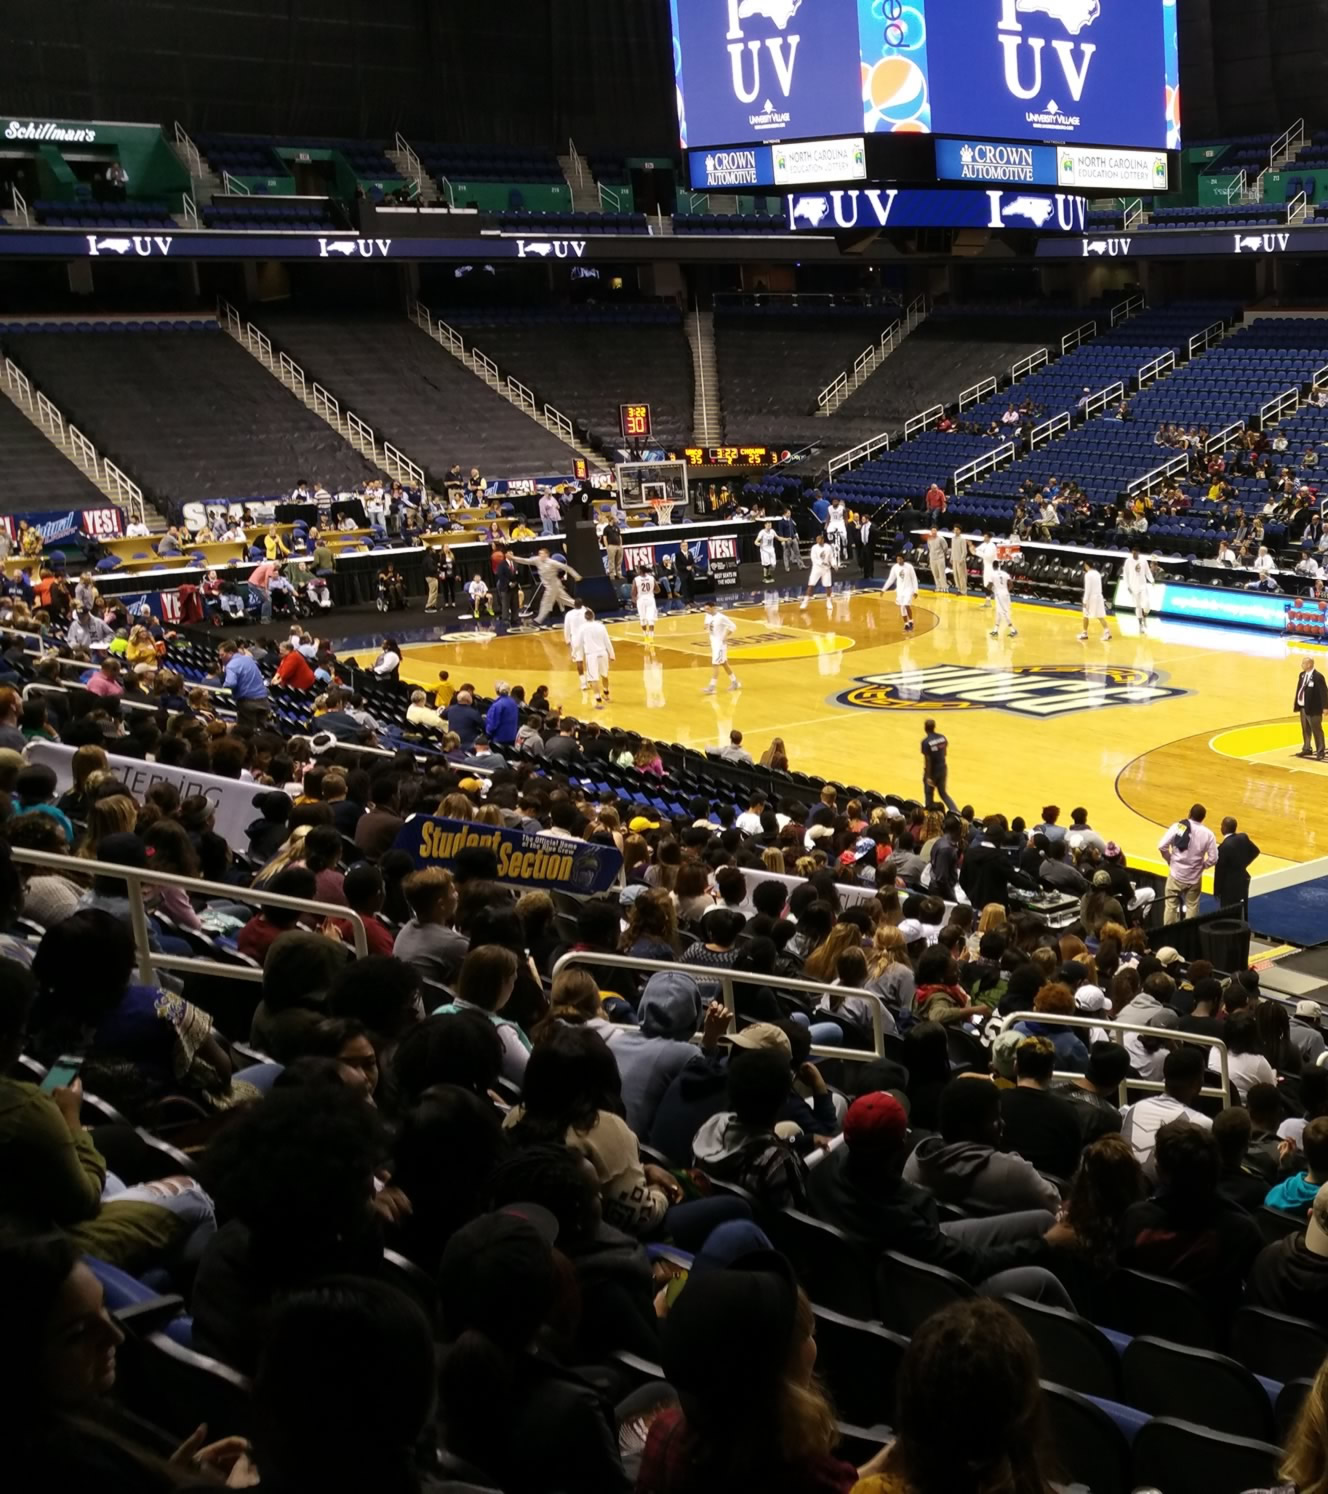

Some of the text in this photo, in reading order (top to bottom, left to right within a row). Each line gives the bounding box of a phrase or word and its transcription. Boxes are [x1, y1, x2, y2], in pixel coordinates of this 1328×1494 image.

[727, 35, 800, 103] UV
[998, 34, 1096, 102] UV
[714, 151, 755, 170] CROWN
[789, 149, 848, 163] NORTH CAROLINA
[974, 145, 1032, 165] CROWN
[1078, 157, 1148, 170] NORTH CAROLINA
[707, 171, 757, 186] AUTOMOTIVE
[961, 165, 1033, 181] AUTOMOTIVE
[1078, 169, 1149, 180] EDUCATION LOTTERY
[830, 190, 898, 227] UV
[1055, 194, 1085, 231] UV
[133, 237, 172, 255] UV
[357, 239, 391, 257] UV
[553, 241, 586, 257] UV
[1107, 238, 1131, 256] UV
[1263, 233, 1290, 252] UV
[628, 407, 646, 417] 3:22
[627, 417, 645, 433] 30
[84, 509, 118, 534] YES!
[709, 540, 734, 559] YES!
[625, 547, 652, 571] YES!
[641, 582, 651, 592] 20
[498, 842, 574, 881] Section
